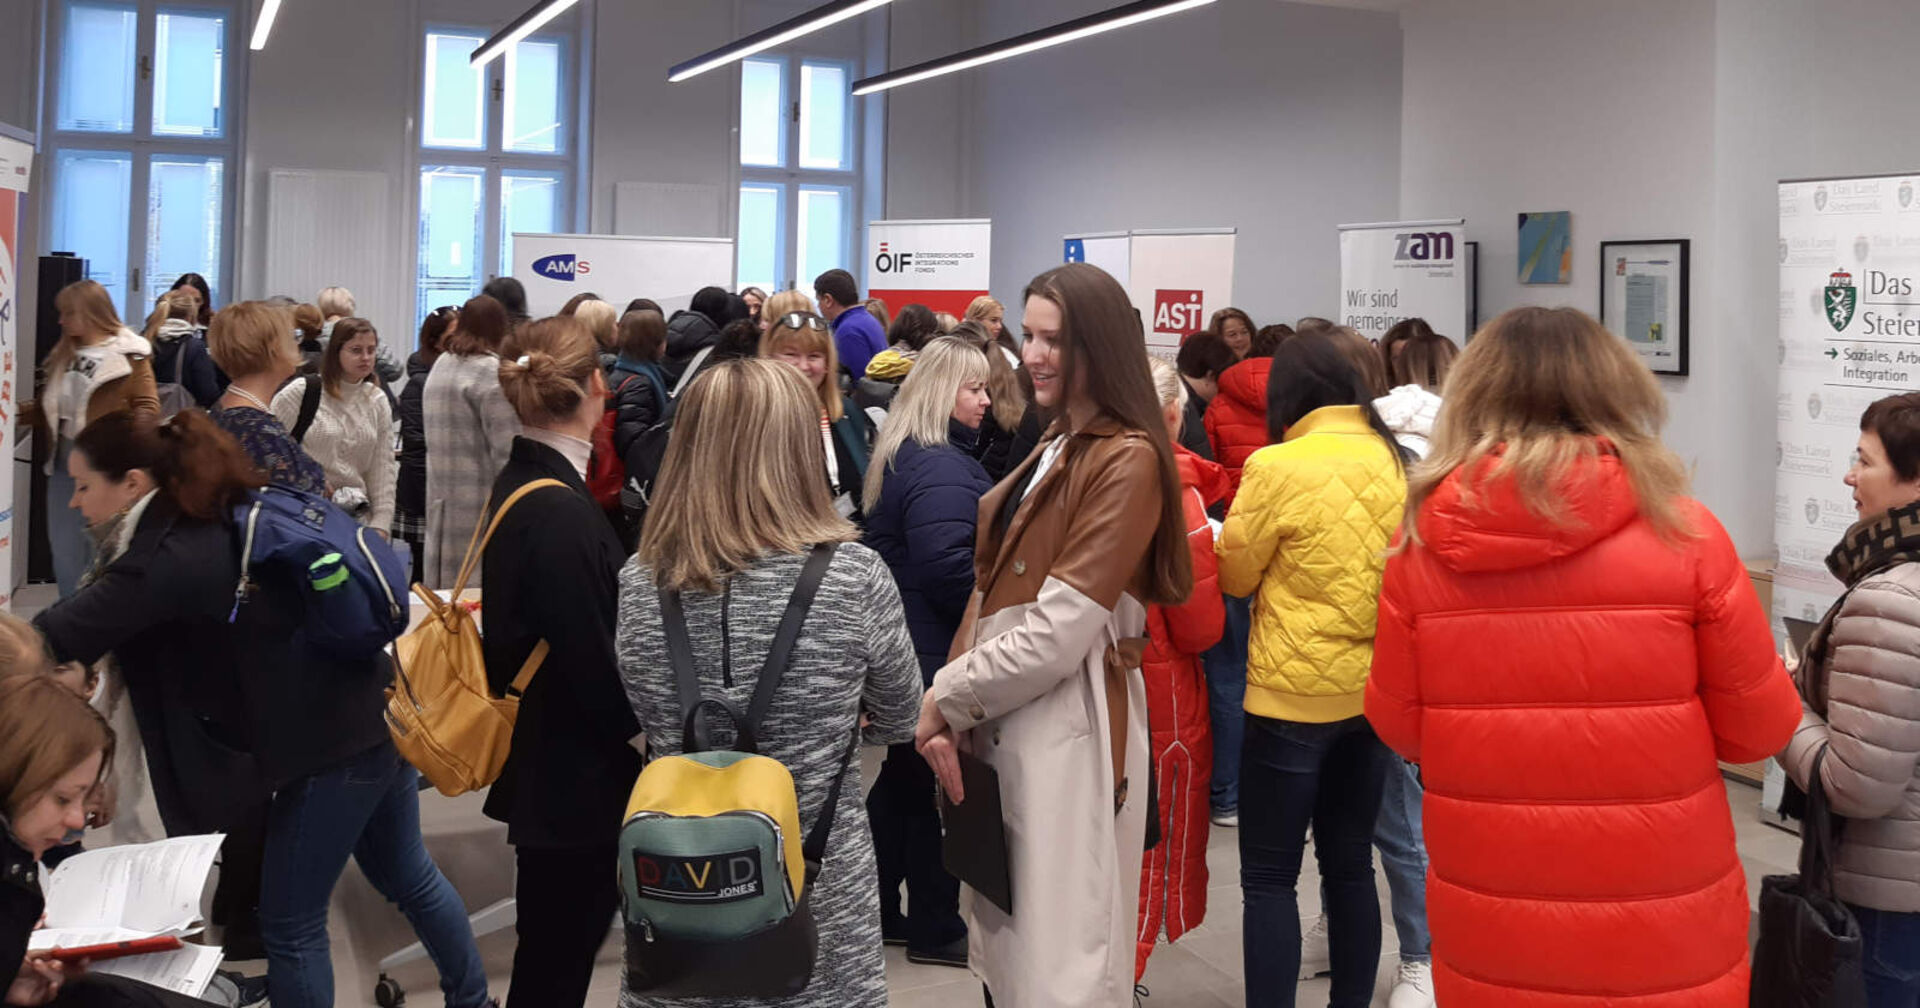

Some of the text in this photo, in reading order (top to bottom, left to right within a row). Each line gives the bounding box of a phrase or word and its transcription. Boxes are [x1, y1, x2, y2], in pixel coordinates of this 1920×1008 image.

[1394, 232, 1454, 260] zam
[545, 260, 590, 274] AMS
[875, 242, 912, 273] ÖIF
[1869, 271, 1912, 296] Das
[1347, 288, 1398, 308] Wir sind
[1347, 312, 1409, 330] gemein
[1843, 347, 1892, 363] Soziales,
[1843, 365, 1909, 383] Integration
[638, 856, 755, 889] DAVID
[717, 881, 757, 897] JONES
